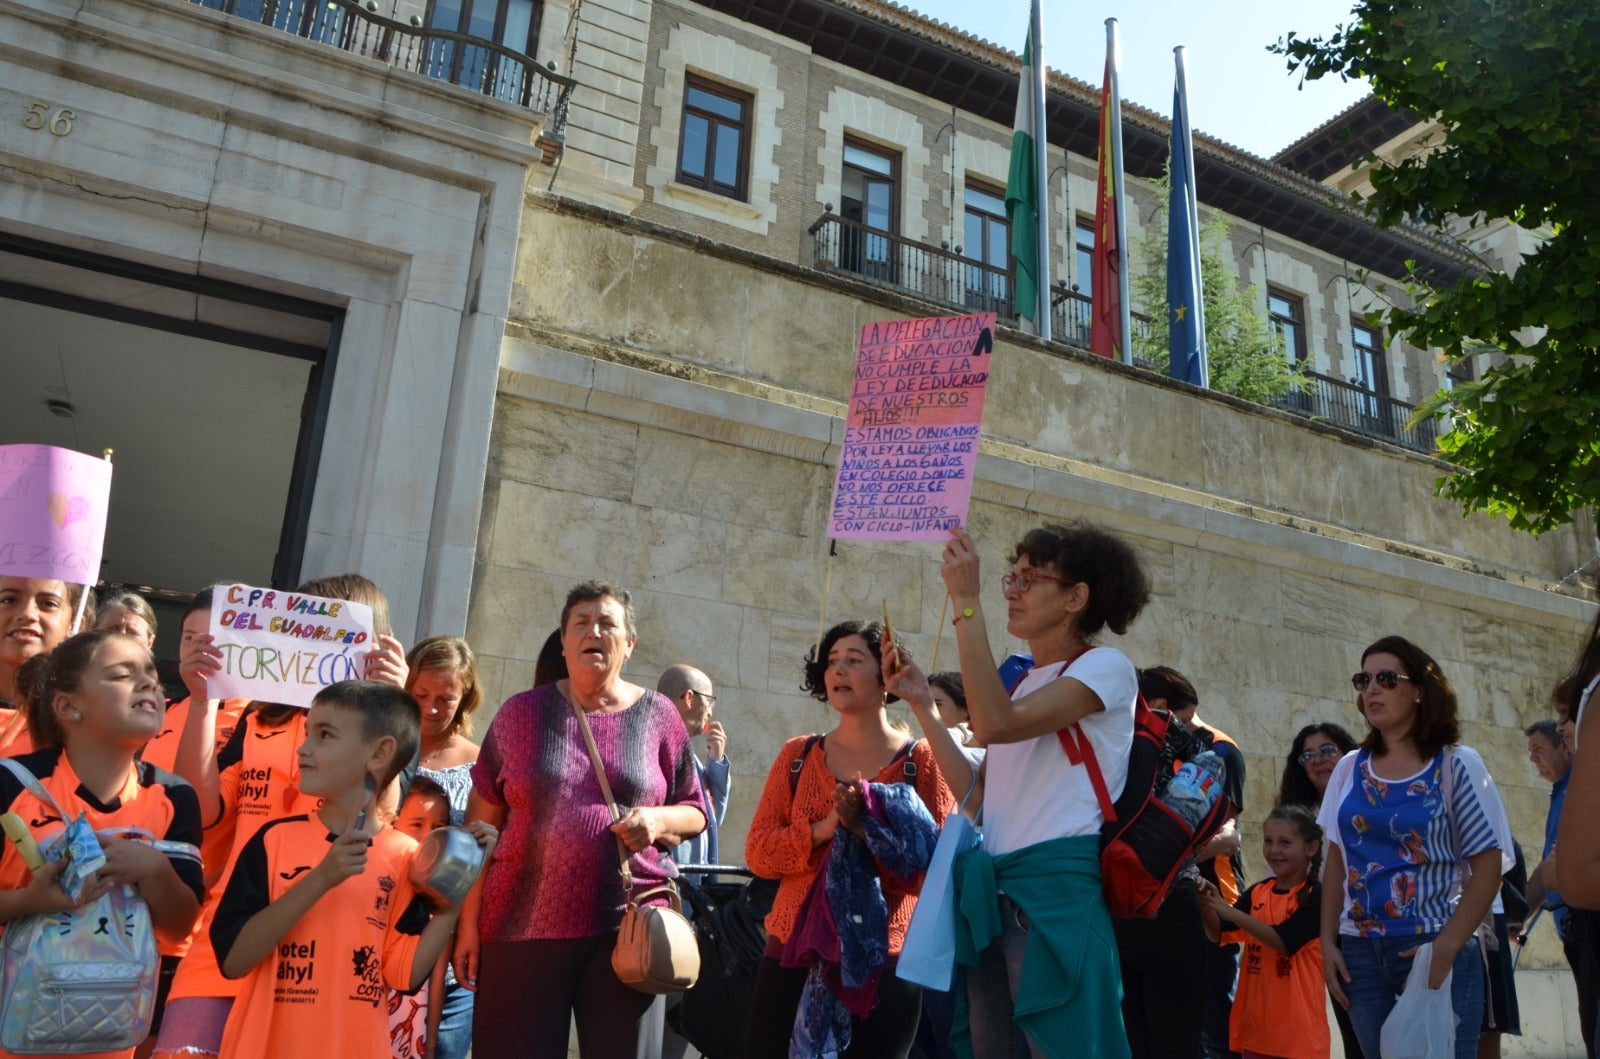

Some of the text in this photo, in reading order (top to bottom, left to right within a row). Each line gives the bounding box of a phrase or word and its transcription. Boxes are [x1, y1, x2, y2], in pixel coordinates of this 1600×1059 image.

[23, 100, 76, 137] 56
[860, 314, 989, 346] LA DELEGACION
[859, 339, 976, 363] DE EDUCACION
[855, 357, 971, 378] NO CUMPLE LA
[854, 380, 888, 397] LEY
[895, 377, 917, 392] DE
[856, 391, 969, 414] DE NUESTROS
[844, 425, 978, 443] ESTAMOS OBLIGADOS
[843, 442, 972, 458] POR LEY A LLEVAR LOS
[882, 459, 892, 469] A
[895, 458, 917, 468] LOS
[920, 454, 931, 468] 6
[931, 454, 962, 467] AÑOS
[839, 469, 965, 481] EN COLEGIO DONDE
[837, 480, 946, 492] NO NOS OFRECE
[835, 494, 927, 506] ESTE CICLO
[835, 521, 864, 531] CON
[286, 595, 342, 618] VALLE
[220, 609, 368, 645] DEL GUADALFEO
